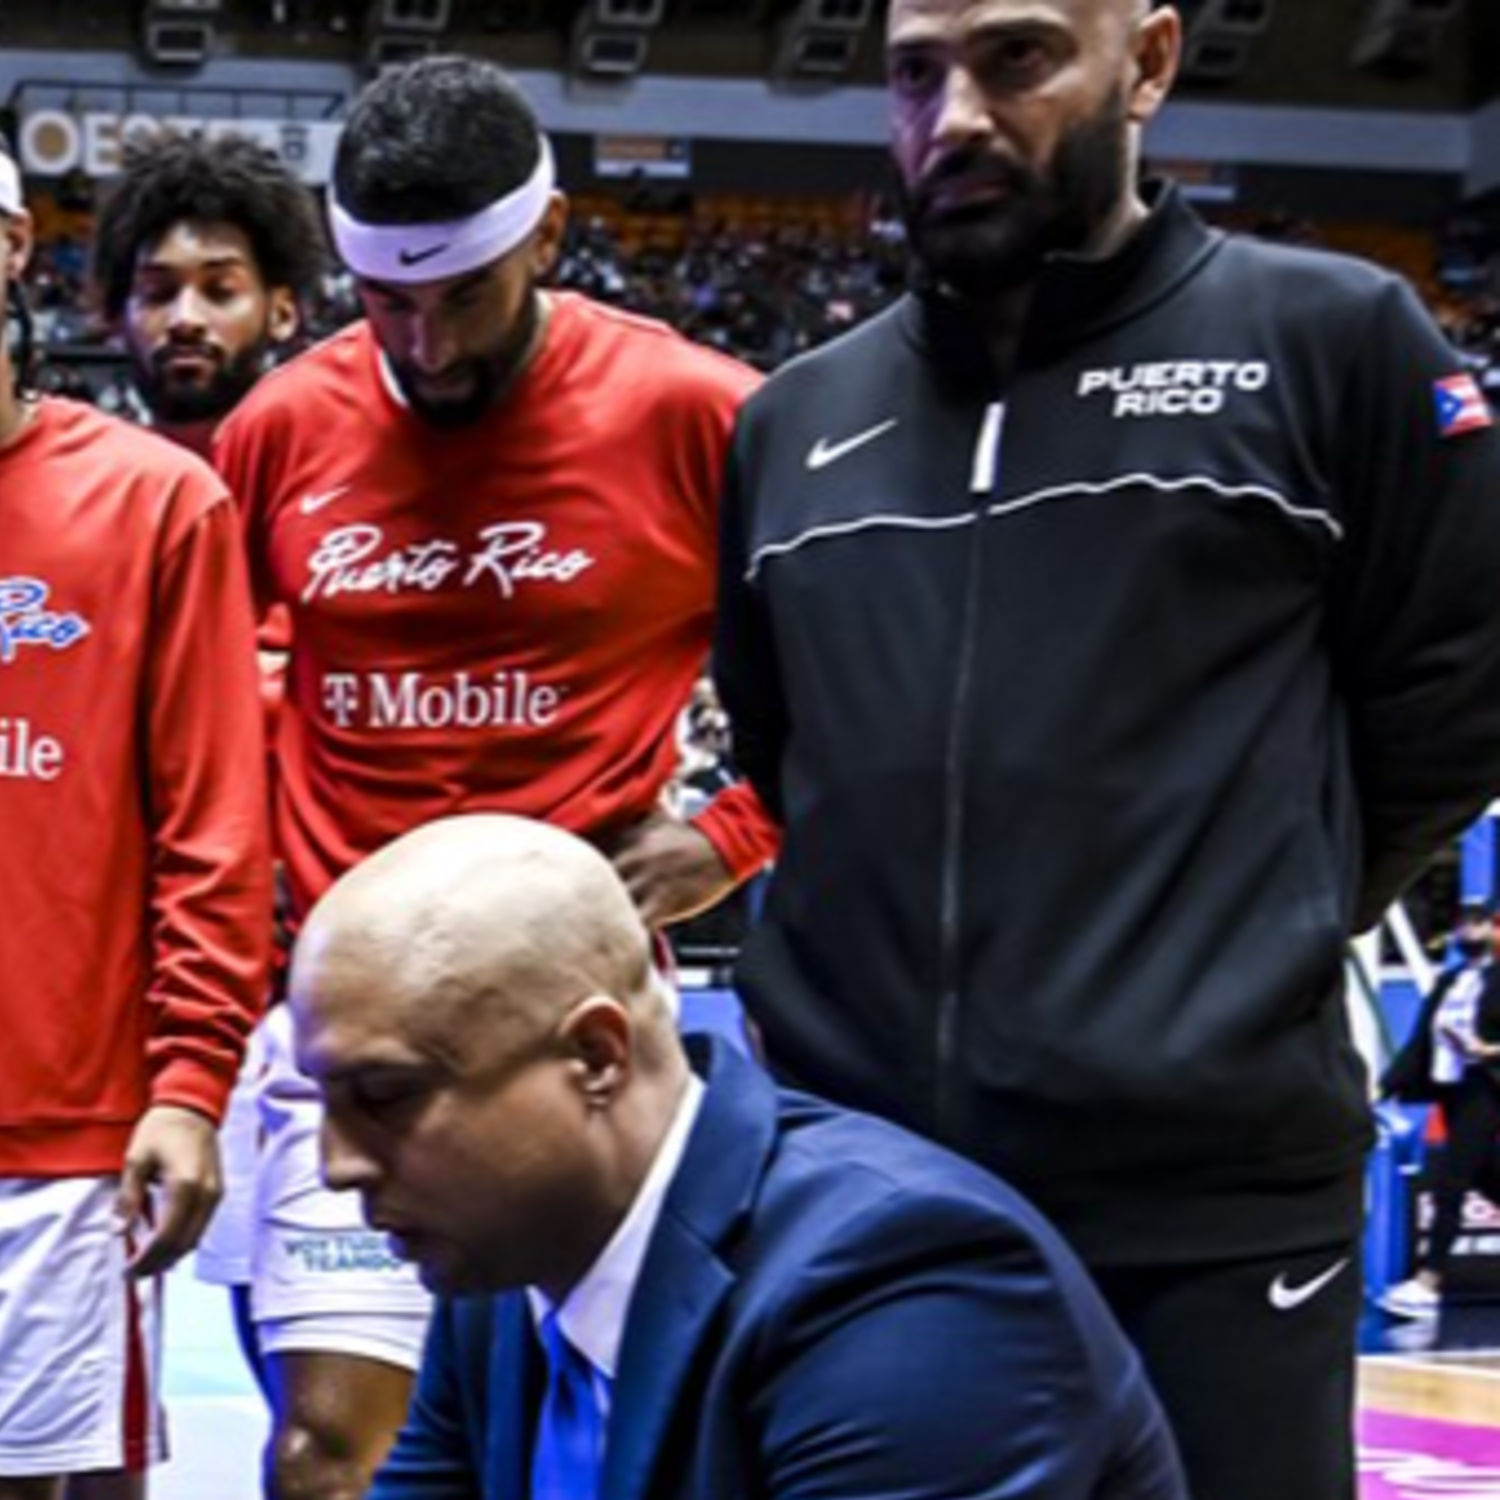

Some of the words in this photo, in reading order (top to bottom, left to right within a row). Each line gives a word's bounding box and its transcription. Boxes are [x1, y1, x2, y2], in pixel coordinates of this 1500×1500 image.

[1077, 360, 1269, 396] PUERTO
[1112, 387, 1224, 418] RICO
[301, 523, 458, 603] Puerto
[462, 521, 596, 599] Rico
[367, 670, 559, 728] Mobile
